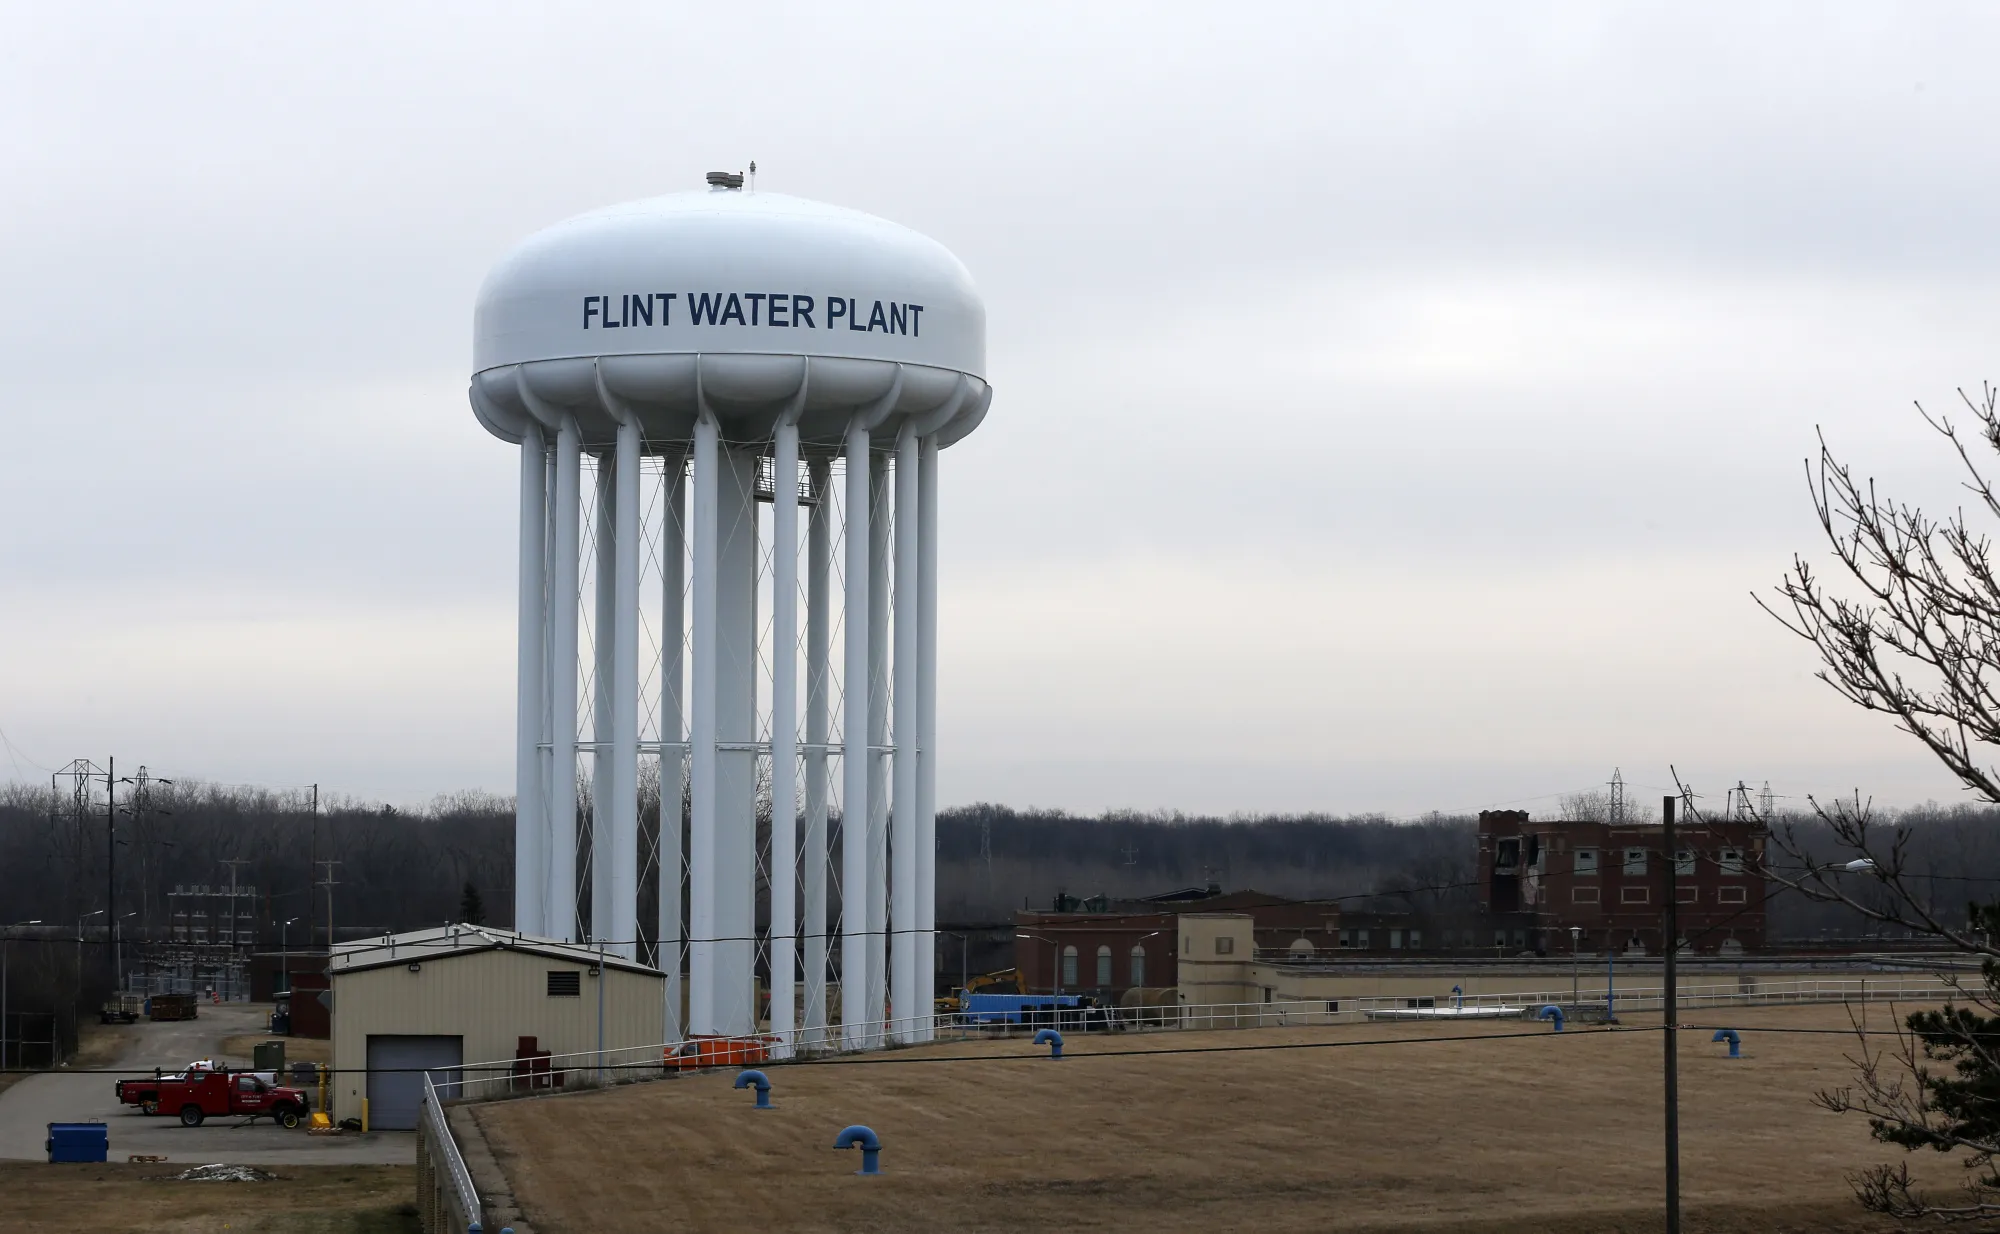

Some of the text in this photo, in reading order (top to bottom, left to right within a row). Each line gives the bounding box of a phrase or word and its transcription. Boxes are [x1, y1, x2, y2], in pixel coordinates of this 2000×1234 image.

[583, 292, 924, 337] FLINT WATER PLANT
